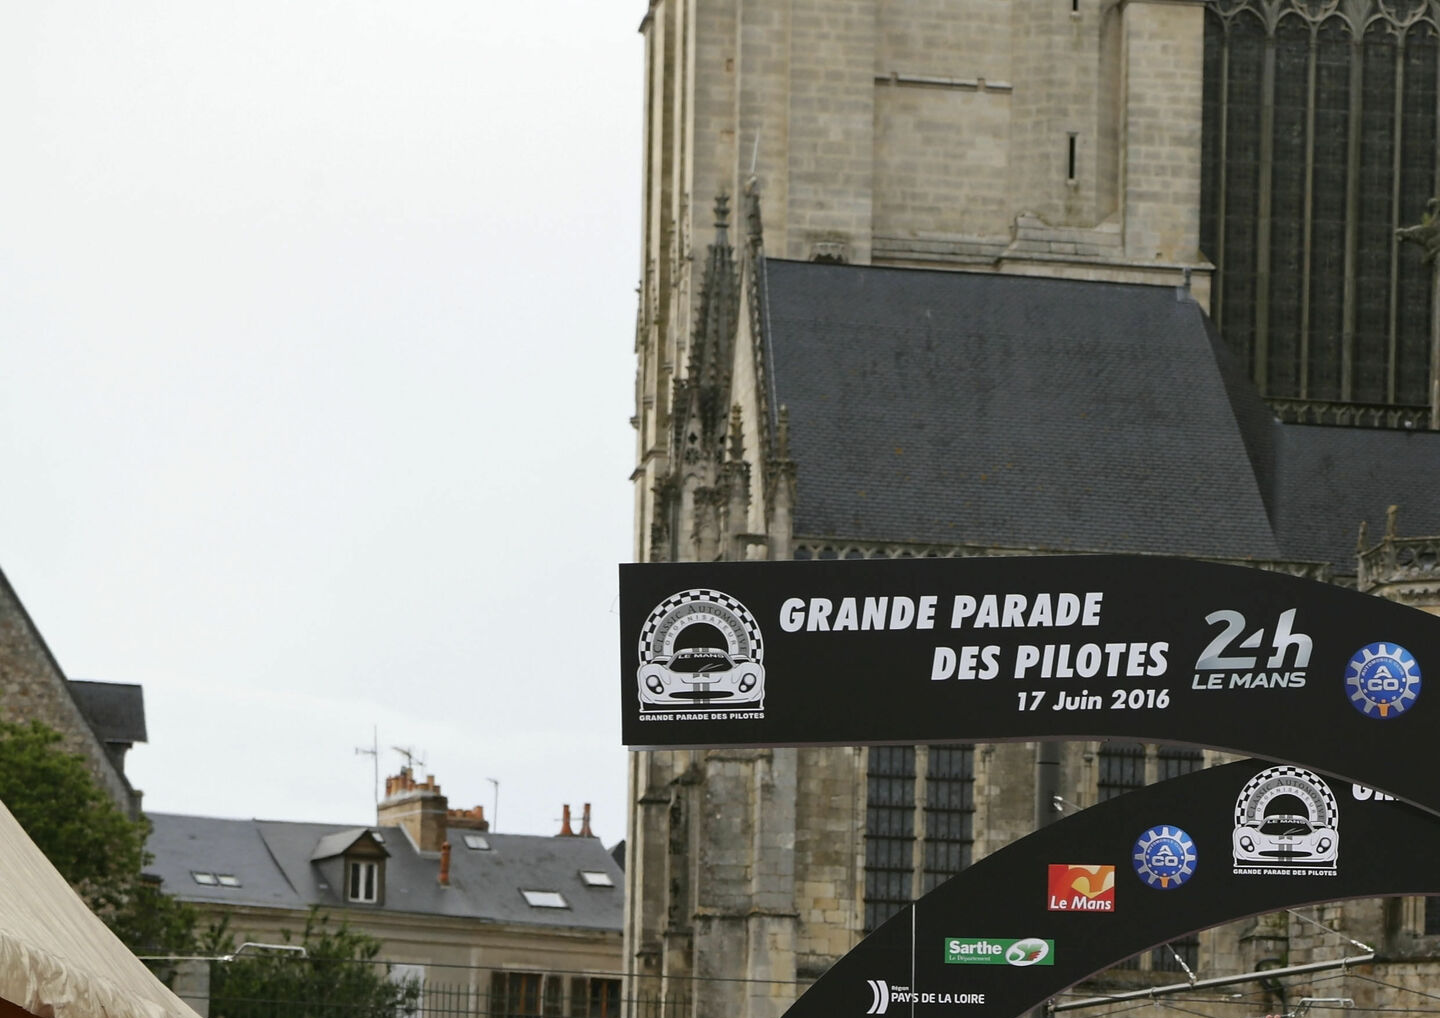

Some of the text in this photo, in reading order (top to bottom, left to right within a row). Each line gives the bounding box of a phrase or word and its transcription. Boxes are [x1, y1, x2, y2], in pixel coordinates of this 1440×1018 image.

[779, 592, 1104, 632] GRANDE PARADE
[653, 604, 748, 653] CLASSIC AUTOMOTIVE
[1195, 608, 1313, 670] 24h
[931, 641, 1170, 681] DES PILOTES
[1192, 671, 1307, 690] LE MANS
[1017, 688, 1171, 712] 17 Juin 2016
[676, 713, 709, 721] PARADE
[730, 712, 765, 720] PILOTES
[1050, 895, 1112, 910] Le Mans
[949, 940, 1002, 955] Sarthe
[891, 992, 985, 1004] PAYS DE LA LOIRE
